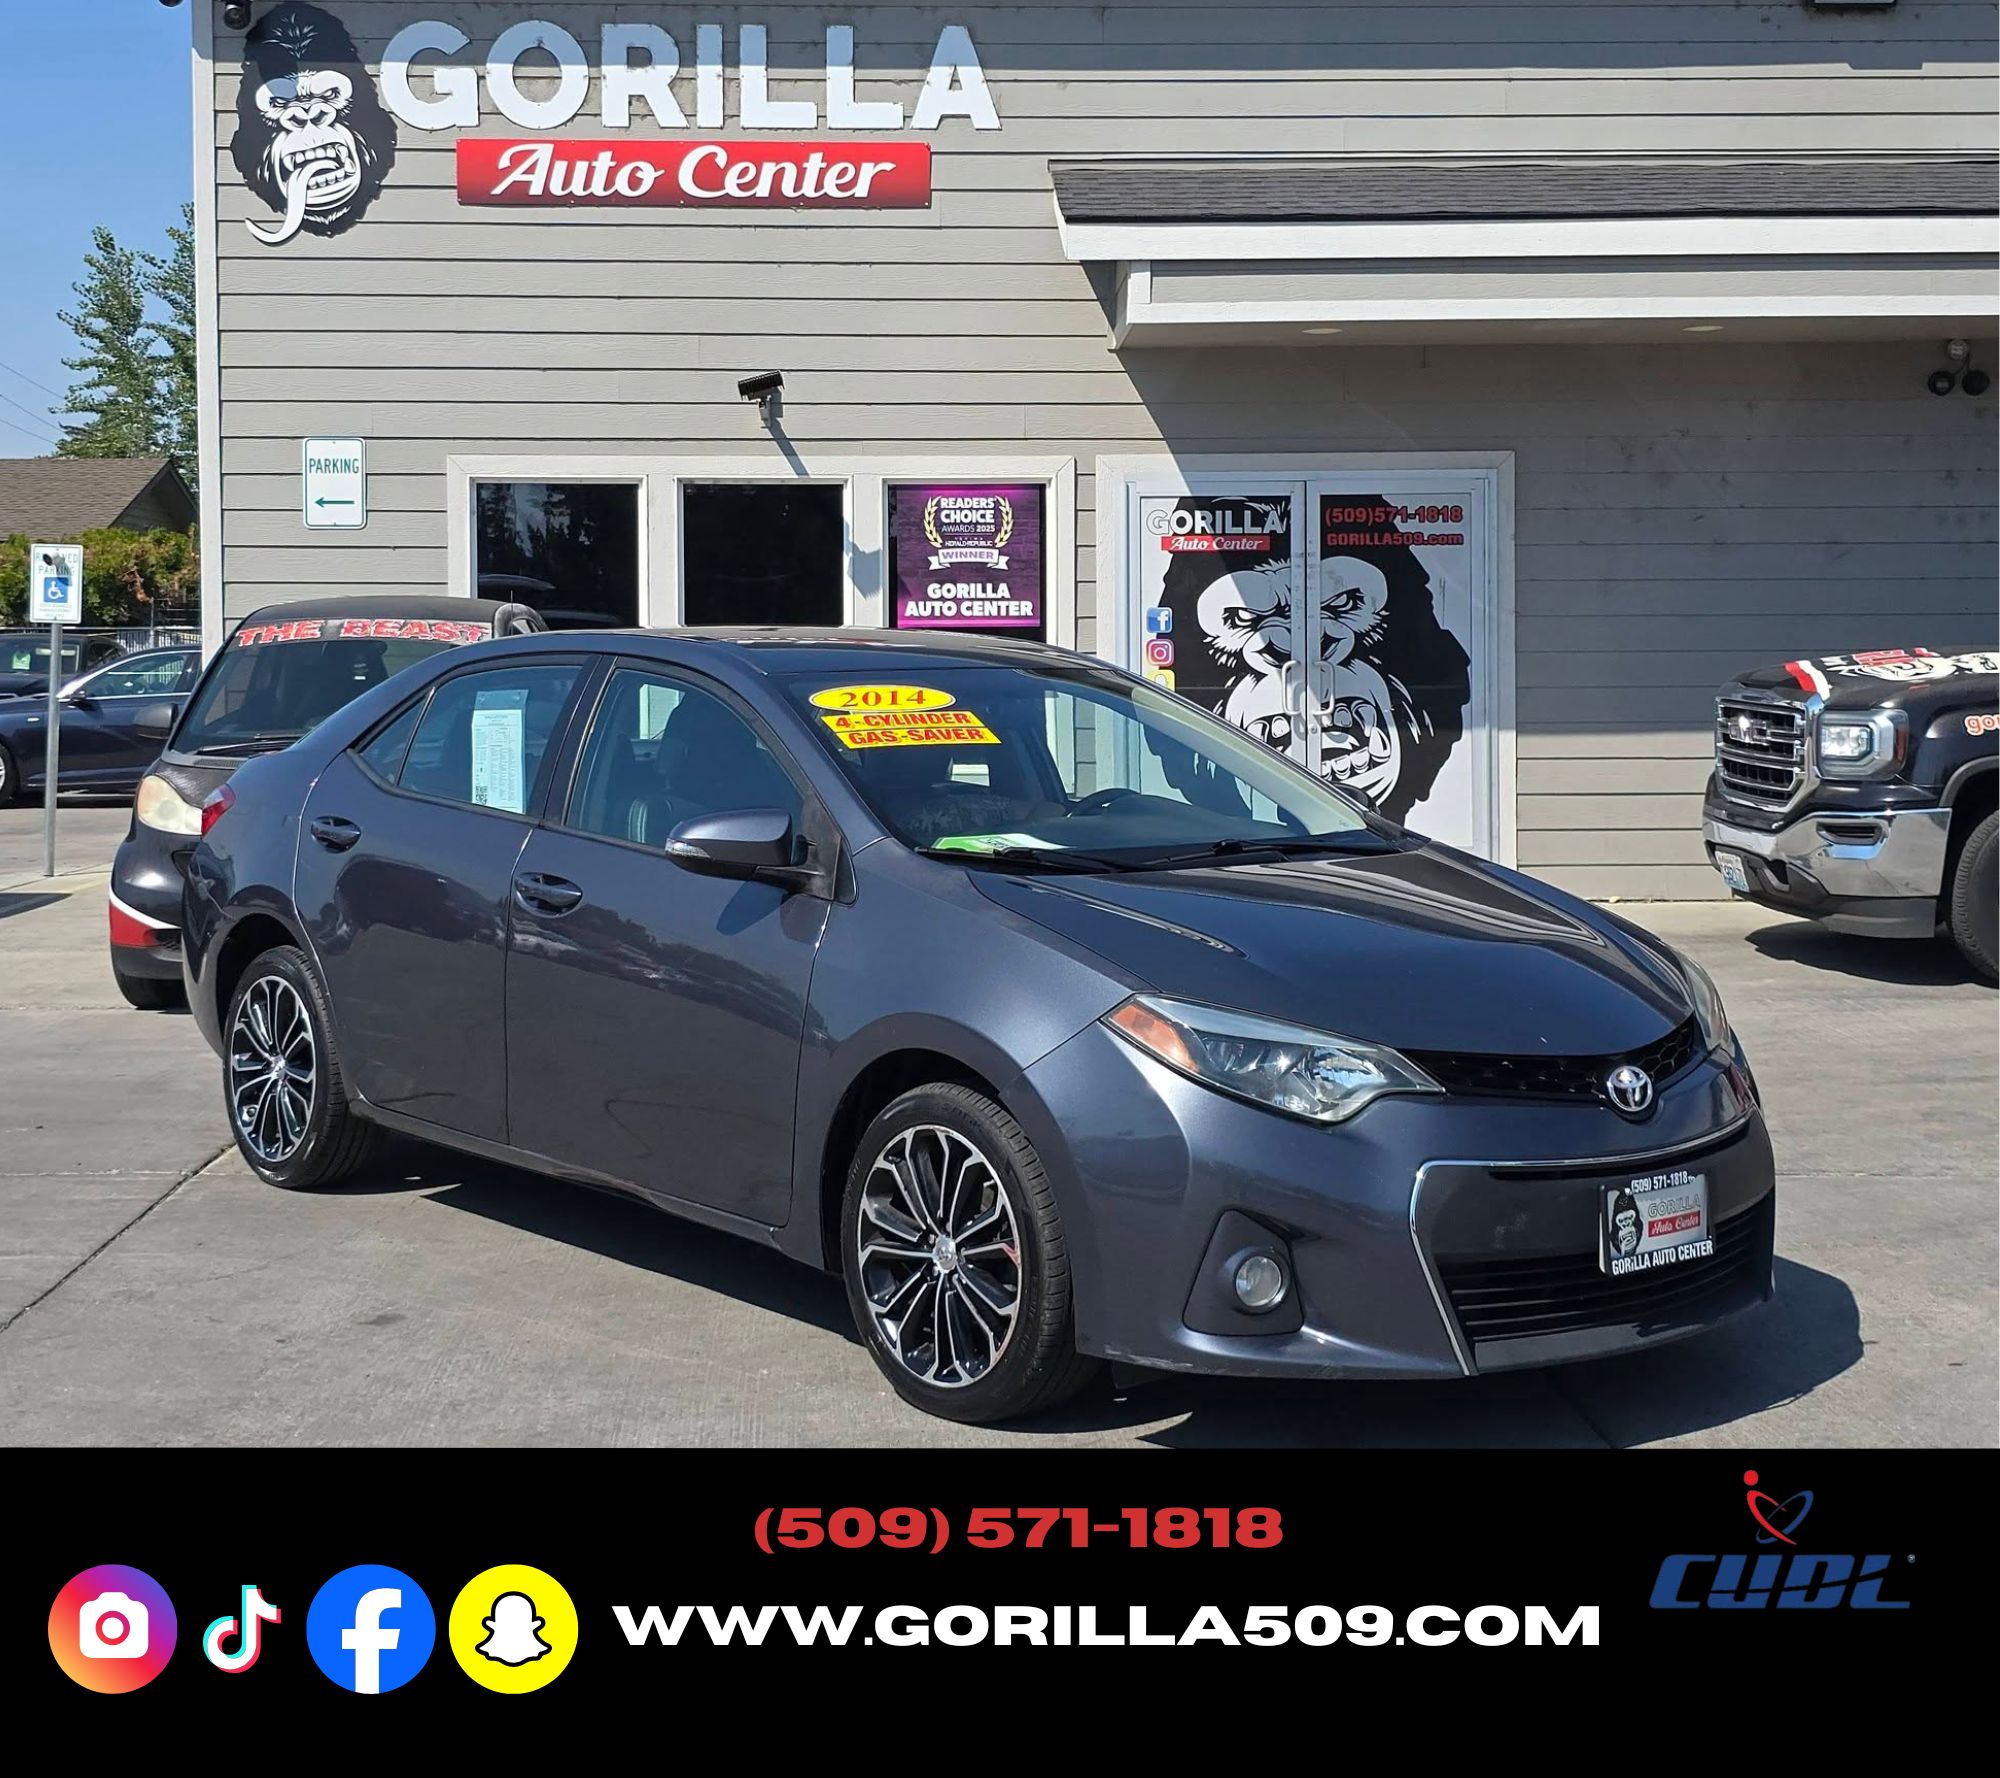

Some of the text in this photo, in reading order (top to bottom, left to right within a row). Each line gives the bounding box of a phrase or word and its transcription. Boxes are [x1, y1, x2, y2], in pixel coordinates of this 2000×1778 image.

[380, 20, 1002, 131] GORILLA
[490, 143, 897, 199] Auto Center
[309, 457, 360, 474] PARKING
[941, 509, 995, 524] CHOICE
[1146, 509, 1284, 535] GORILLA
[1325, 505, 1464, 527] (509)571-1818
[941, 524, 996, 533] AWARDS 2025
[1170, 536, 1263, 550] Auto Center
[1327, 531, 1465, 546] GORILLA509.com
[941, 550, 994, 560] WINNER
[927, 582, 1011, 599] GORILLA
[905, 601, 1033, 617] AUTO CENTER
[234, 618, 490, 647] THE BEAST
[840, 690, 926, 708] 2014
[835, 712, 972, 729] 4-CYLINDER
[849, 728, 985, 745] GAS-SAVER
[1631, 1176, 1651, 1193] (509)
[1653, 1170, 1688, 1190] 571-1818
[1652, 1247, 1677, 1267] AUTO
[1678, 1240, 1714, 1260] CENTER
